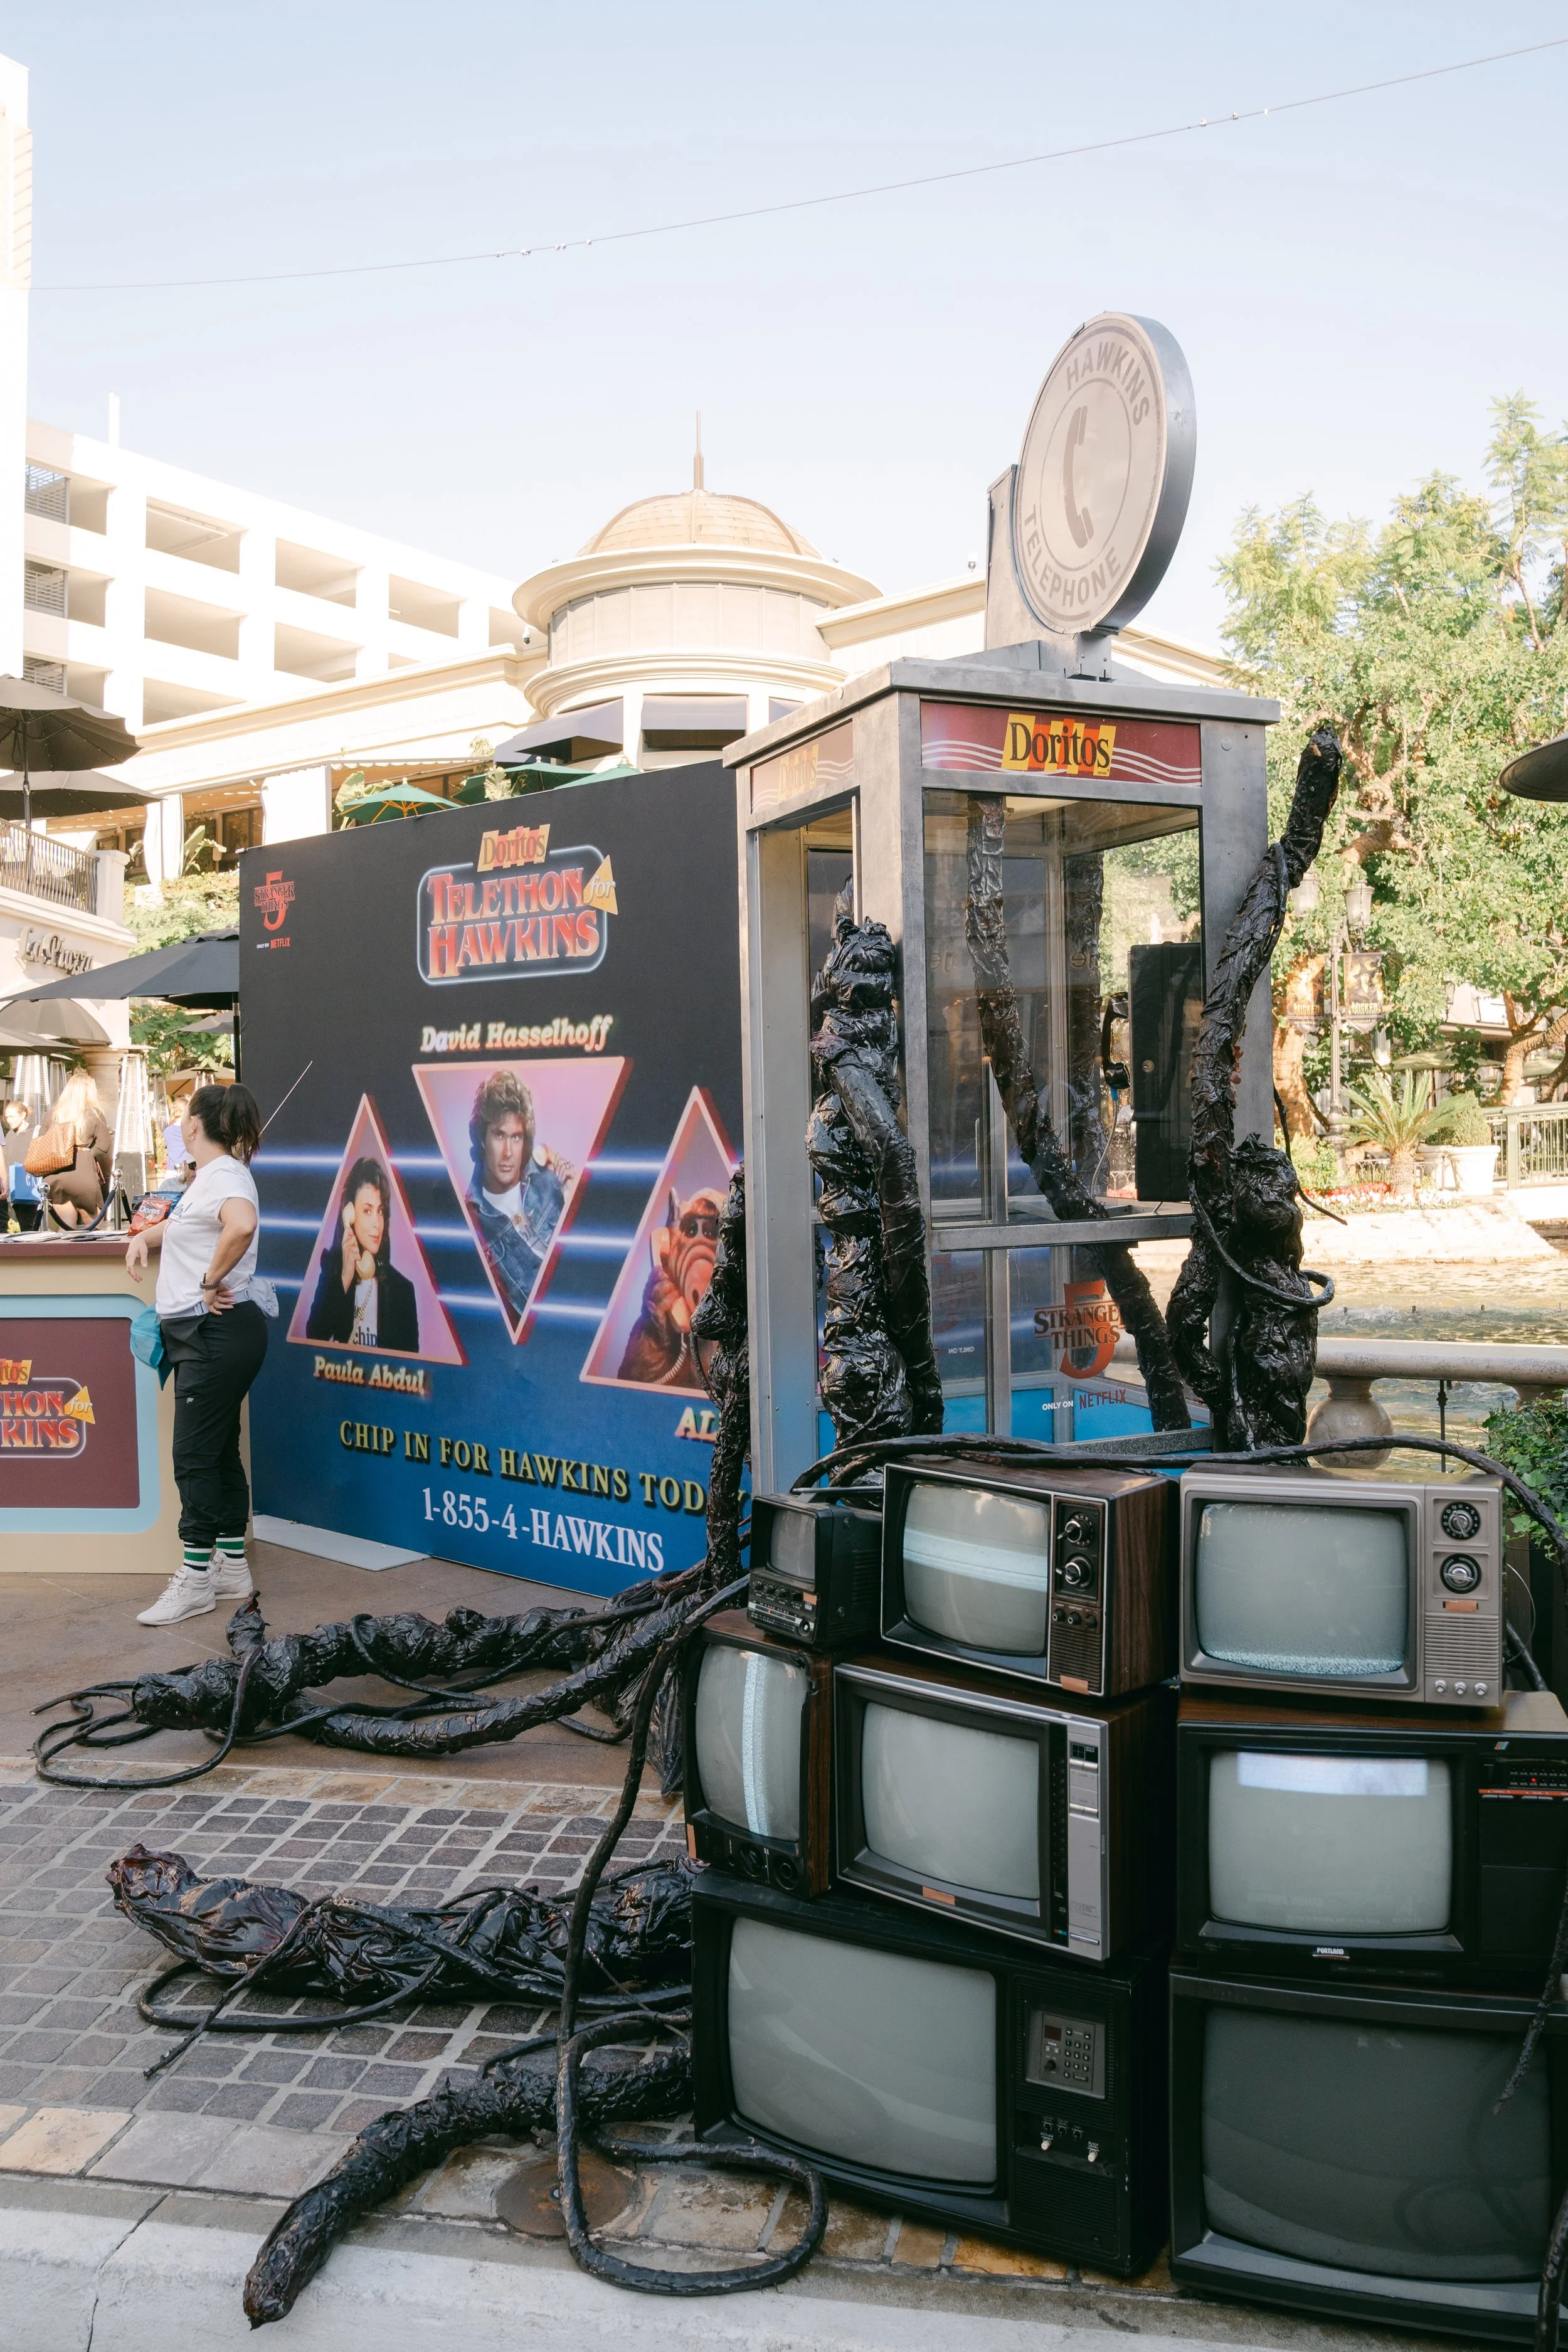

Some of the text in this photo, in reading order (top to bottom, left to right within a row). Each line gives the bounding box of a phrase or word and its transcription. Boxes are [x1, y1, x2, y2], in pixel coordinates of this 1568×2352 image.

[1066, 342, 1150, 426] HAWKINS
[1024, 503, 1121, 608] TELEPHONE
[1009, 722, 1110, 769] Doritos
[780, 756, 817, 794] Doritos
[482, 832, 546, 866] Doritos
[254, 883, 295, 904] STRANGER
[261, 899, 289, 913] THINGS
[427, 867, 616, 925] TELETHON for
[270, 937, 290, 950] NETFLIX
[427, 909, 600, 979] HAWKINS
[1352, 1002, 1378, 1014] WICKED
[420, 1014, 613, 1053] David Hasselhoff
[139, 1205, 161, 1215] Doritos
[1034, 1304, 1123, 1334] STRANGE
[1051, 1325, 1120, 1350] THINGS
[314, 1355, 425, 1395] Paula Abdul
[68, 1397, 93, 1415] for
[1042, 1389, 1127, 1411] ONLY ON NETFLIX
[0, 1419, 80, 1448] KINS
[674, 1407, 719, 1442] AL
[340, 1421, 746, 1512] CHIP IN FOR HAWKINS TOD
[1316, 1947, 1344, 1955] PORTLAND
